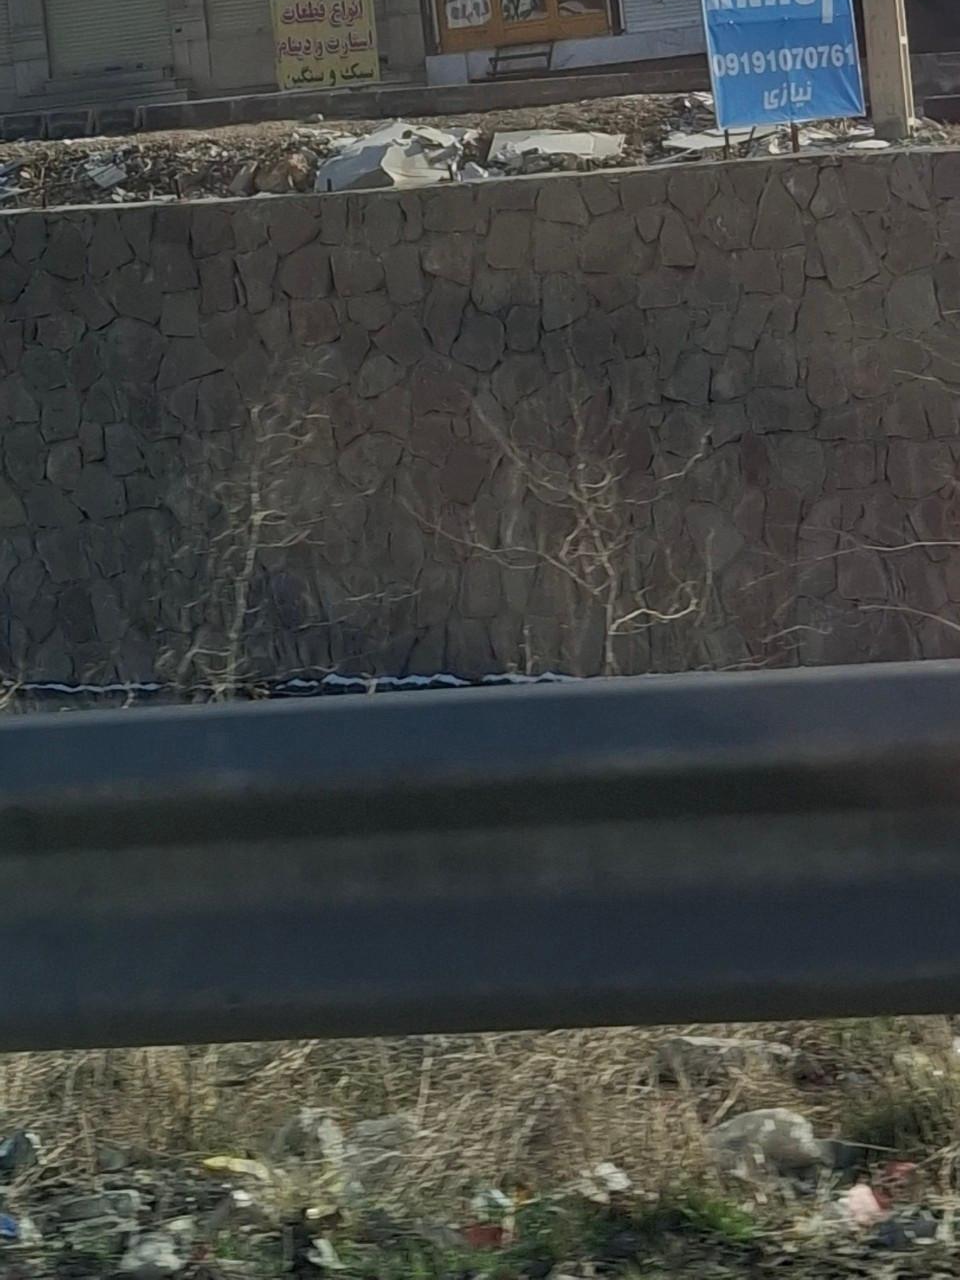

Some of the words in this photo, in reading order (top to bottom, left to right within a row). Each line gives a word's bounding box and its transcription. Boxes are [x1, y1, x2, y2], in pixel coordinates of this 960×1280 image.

[282, 1, 325, 23] قطعات
[330, 0, 363, 26] انواع
[712, 43, 855, 77] 09191070761
[763, 79, 813, 111] نیازی
